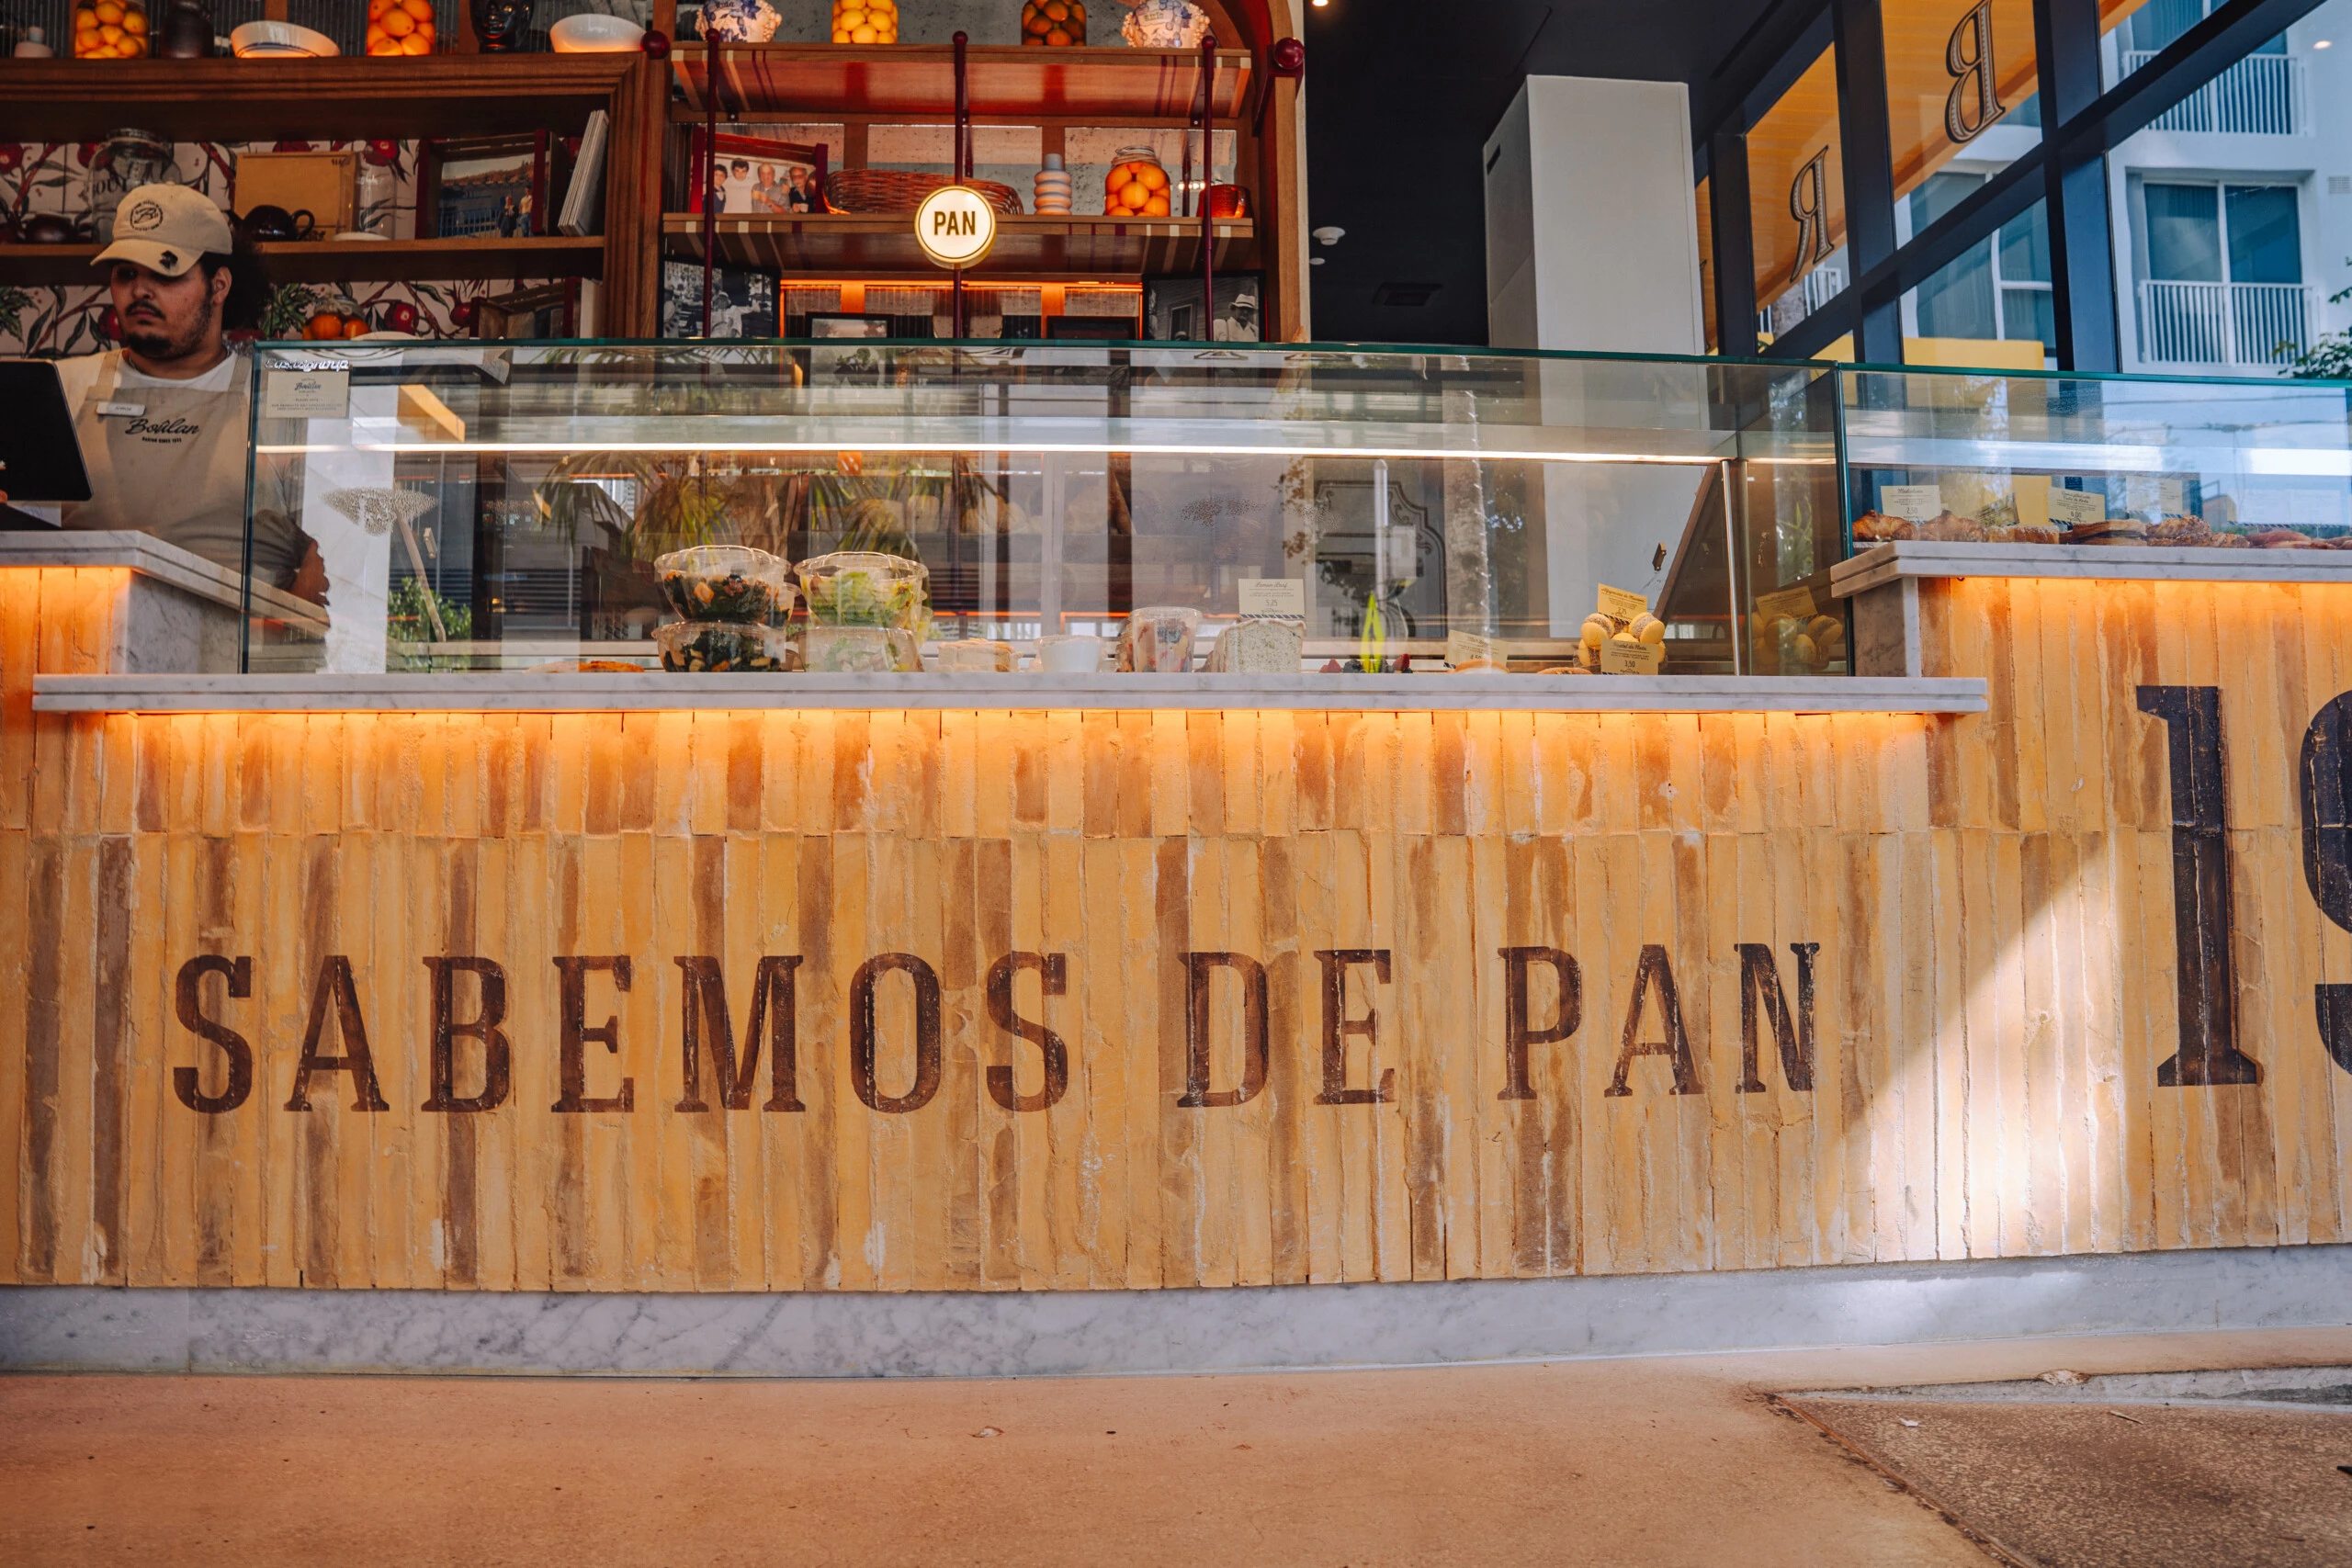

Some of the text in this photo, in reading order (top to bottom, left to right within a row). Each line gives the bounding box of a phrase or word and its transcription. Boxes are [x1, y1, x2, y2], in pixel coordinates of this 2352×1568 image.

[933, 210, 976, 236] PAN
[1624, 660, 1636, 668] 3,50
[173, 942, 1819, 1113] SABEMOS DE PAN
